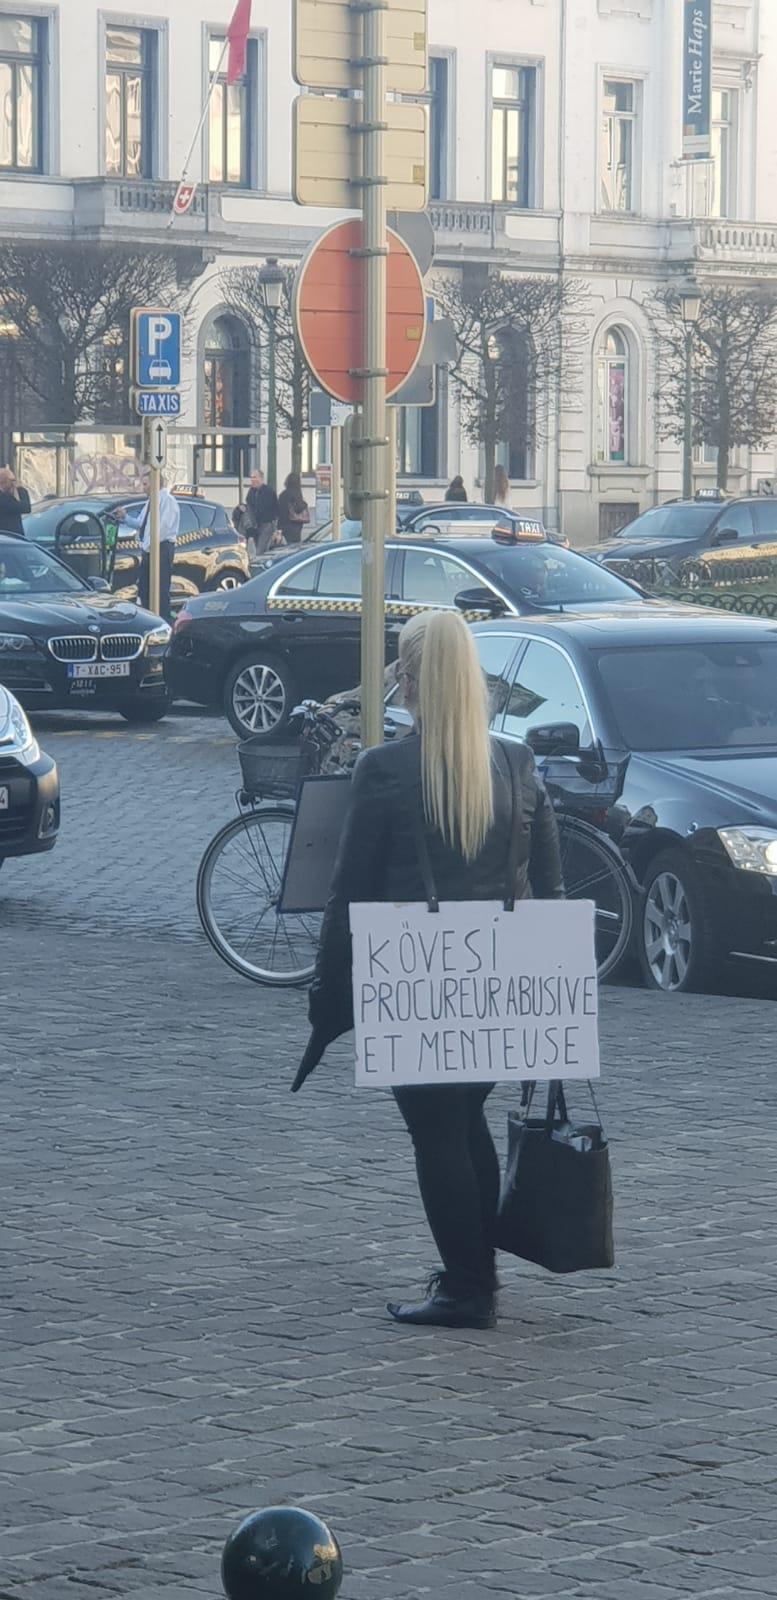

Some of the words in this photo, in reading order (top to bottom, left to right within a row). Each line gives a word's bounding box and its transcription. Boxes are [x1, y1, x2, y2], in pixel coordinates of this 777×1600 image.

[687, 8, 709, 58] Haps
[687, 59, 703, 115] Marie
[148, 317, 172, 356] P
[142, 394, 178, 412] TAXIS
[519, 521, 541, 533] TAXI
[74, 663, 128, 676] T-XAC-951
[361, 977, 505, 1024] PROCUREUR
[364, 1034, 403, 1074] ET
[419, 1026, 579, 1072] MENTEUSE
